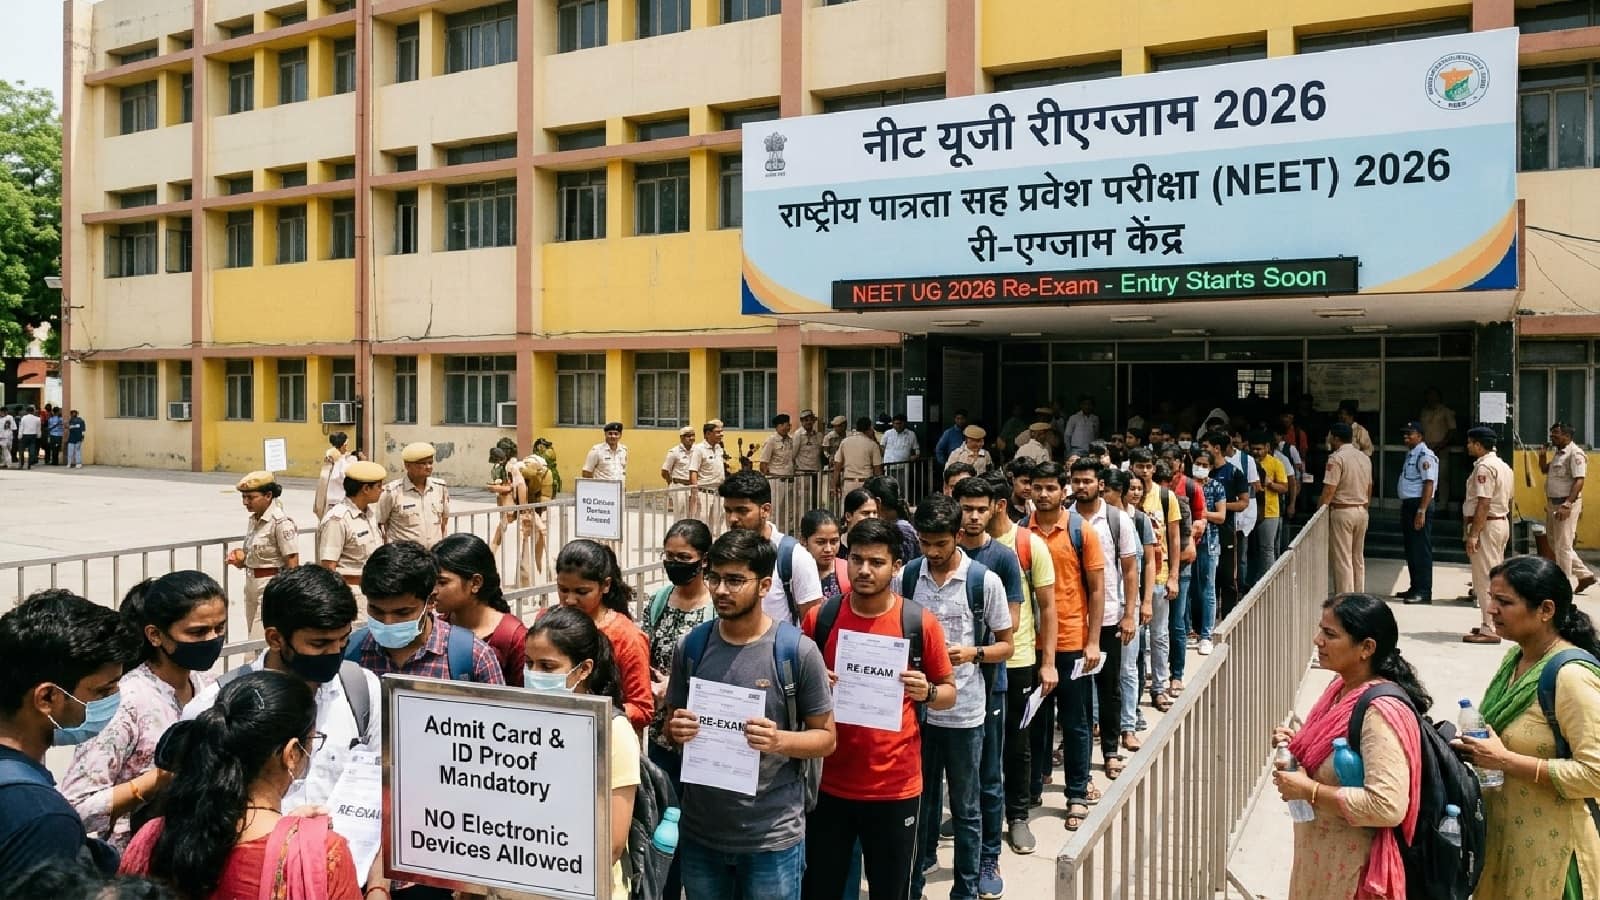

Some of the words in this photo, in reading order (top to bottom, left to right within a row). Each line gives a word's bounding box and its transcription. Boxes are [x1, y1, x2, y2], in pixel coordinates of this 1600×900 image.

[862, 116, 927, 163] नीट
[936, 103, 1016, 169] यूजी
[1027, 95, 1199, 151] रीएग्जाम
[1213, 80, 1327, 130] 2026
[778, 190, 862, 233] राष्ट्रीय
[868, 190, 952, 221] पात्रता
[960, 185, 1009, 217] सह
[1017, 170, 1093, 212] प्रवेश
[1100, 163, 1200, 205] परीक्षा
[1212, 156, 1340, 206] (NEET)
[1353, 148, 1451, 187] 2026
[967, 224, 1117, 266] री-एग्जाम
[1125, 215, 1186, 256] केंद्र
[852, 283, 906, 303] NEET
[912, 281, 943, 302] UG
[947, 279, 996, 300] 2026
[1002, 277, 1099, 297] Re-Exam
[1121, 273, 1180, 296] Entry
[1185, 270, 1256, 290] Starts
[1263, 266, 1327, 288] Soon
[424, 715, 486, 740] Admit
[492, 722, 542, 746] Card
[548, 728, 565, 749] &
[452, 742, 473, 763] ID
[479, 745, 538, 771] Proof
[439, 764, 551, 803] Mandatory
[424, 808, 456, 831] NO
[461, 812, 569, 847] Electronic
[410, 830, 491, 861] Devices
[496, 843, 583, 875] Allowed
